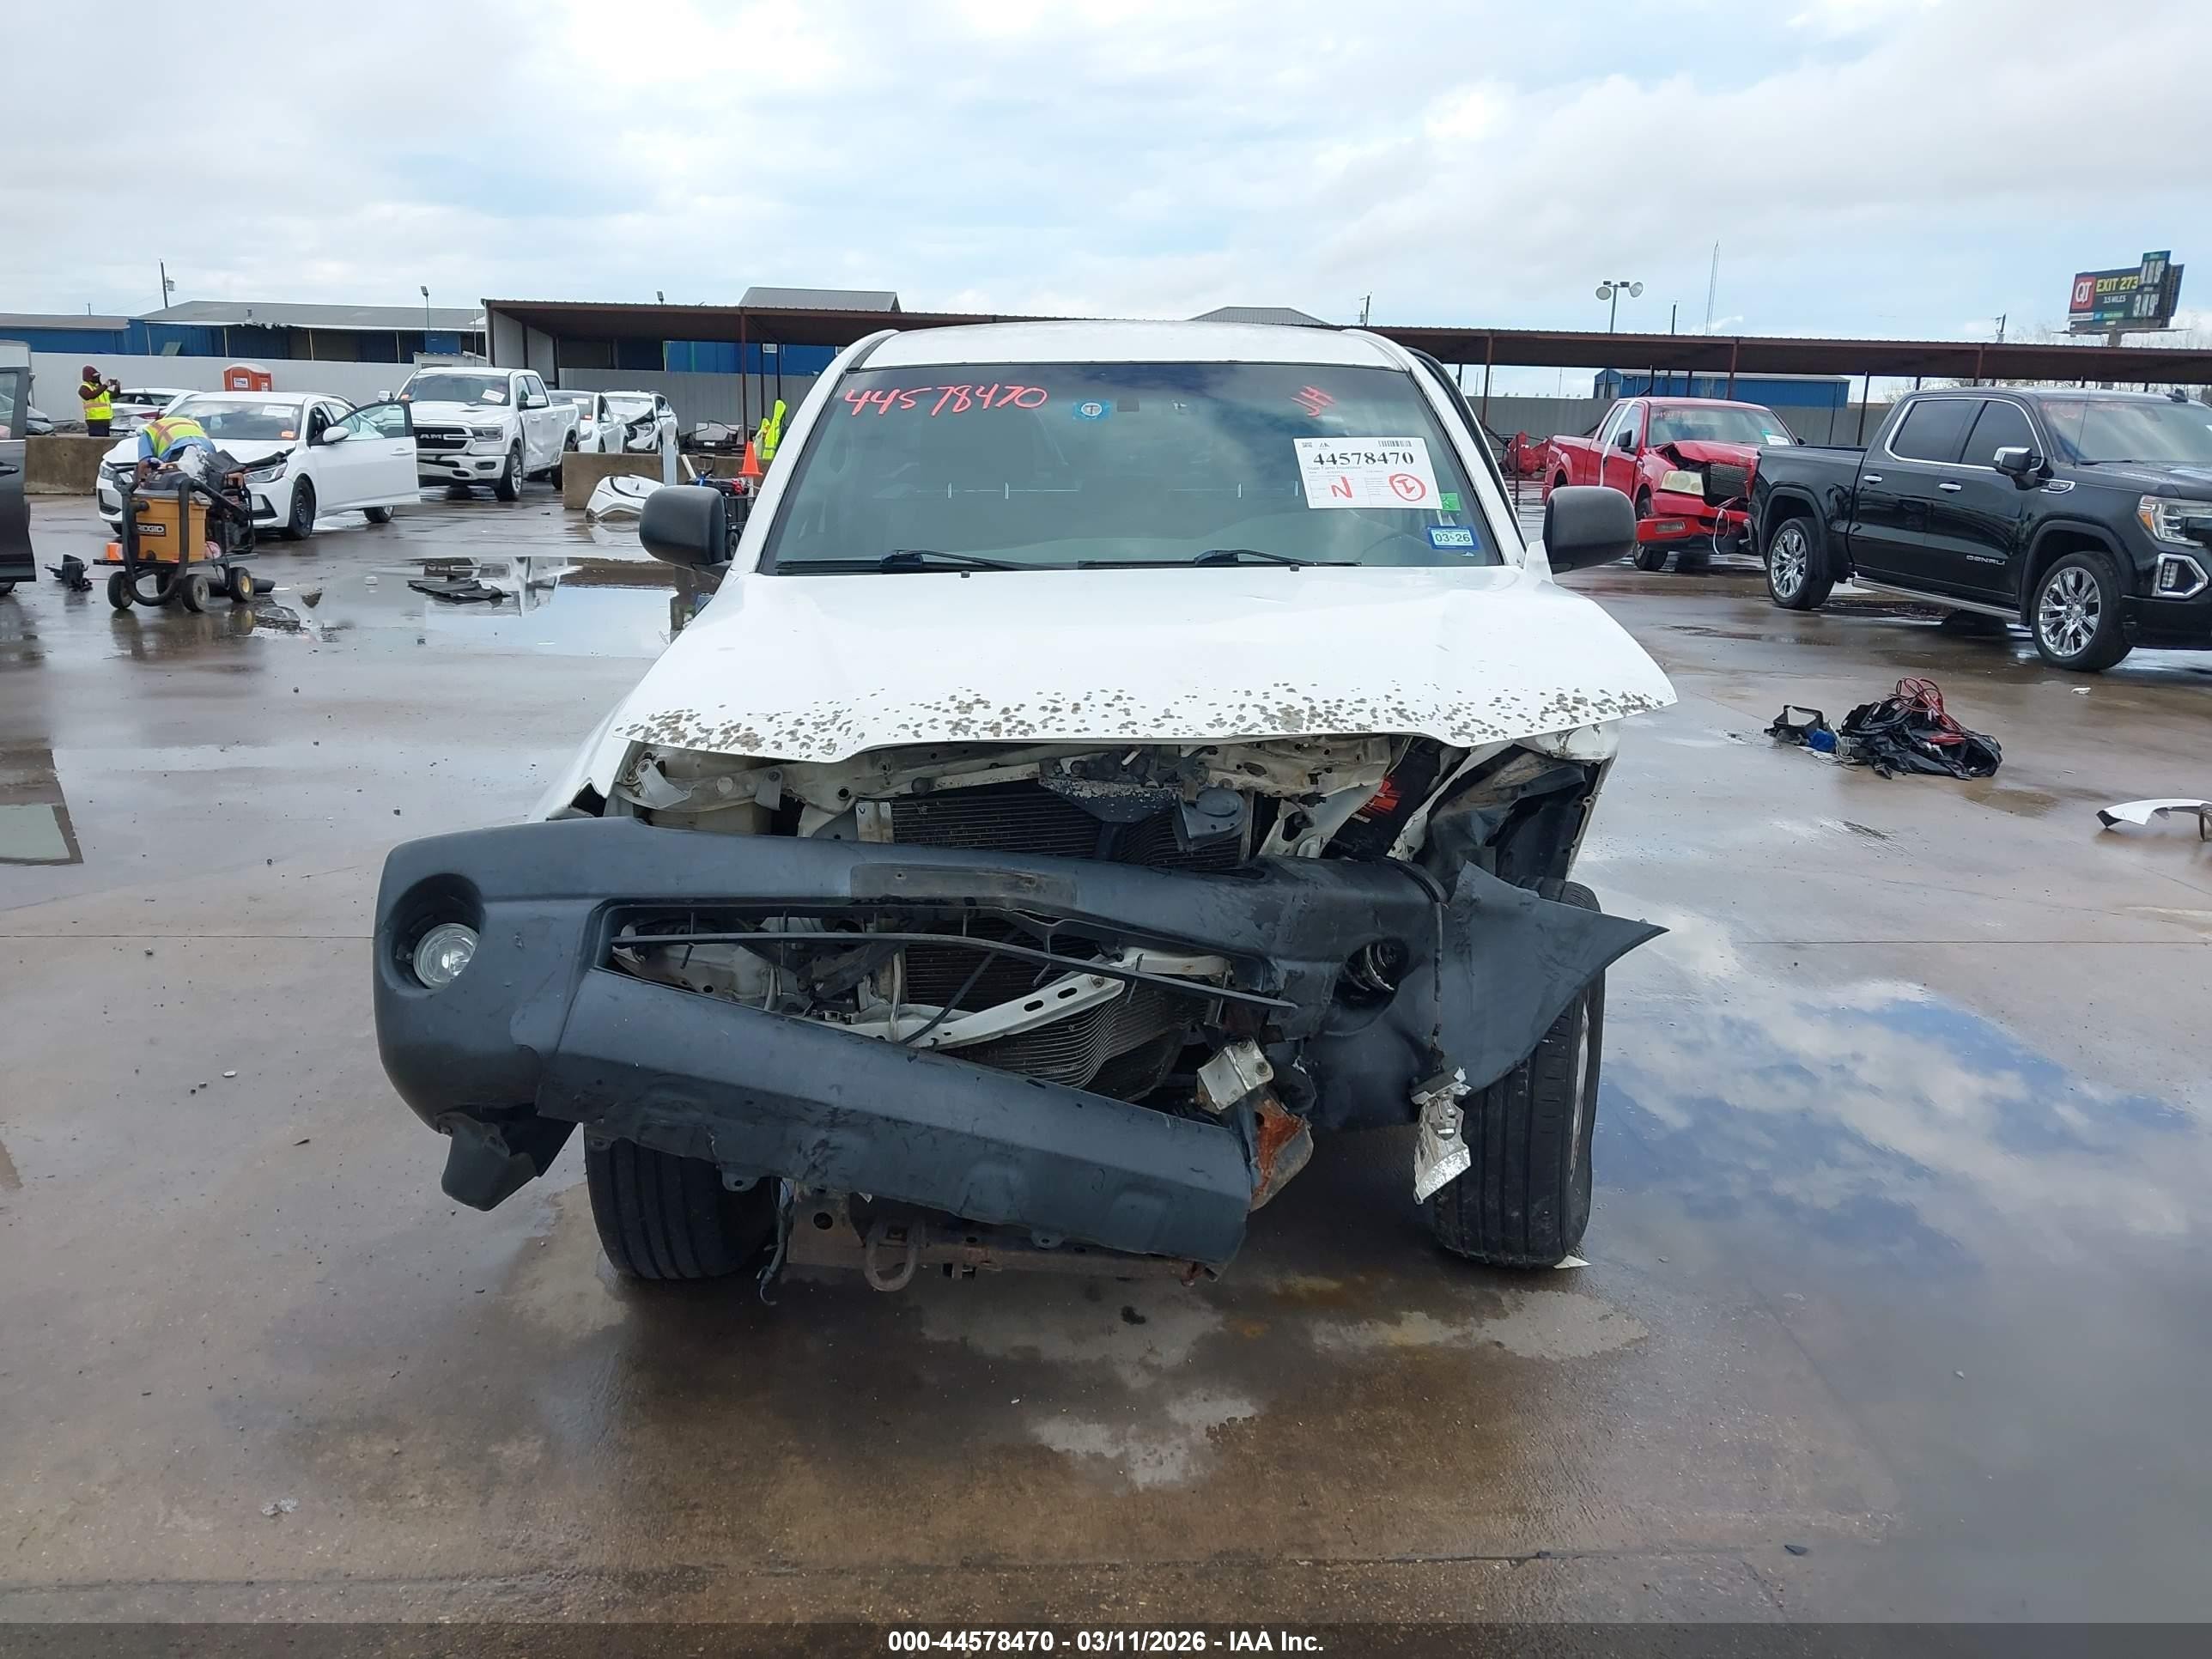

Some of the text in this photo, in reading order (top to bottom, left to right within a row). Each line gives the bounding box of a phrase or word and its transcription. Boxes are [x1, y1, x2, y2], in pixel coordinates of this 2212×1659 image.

[2075, 281, 2093, 303] QT
[2096, 275, 2139, 292] EXIT 273
[844, 383, 1048, 416] 44578470
[1313, 451, 1415, 465] 44578470
[1331, 476, 1353, 499] N
[1966, 555, 2006, 566] DENALI
